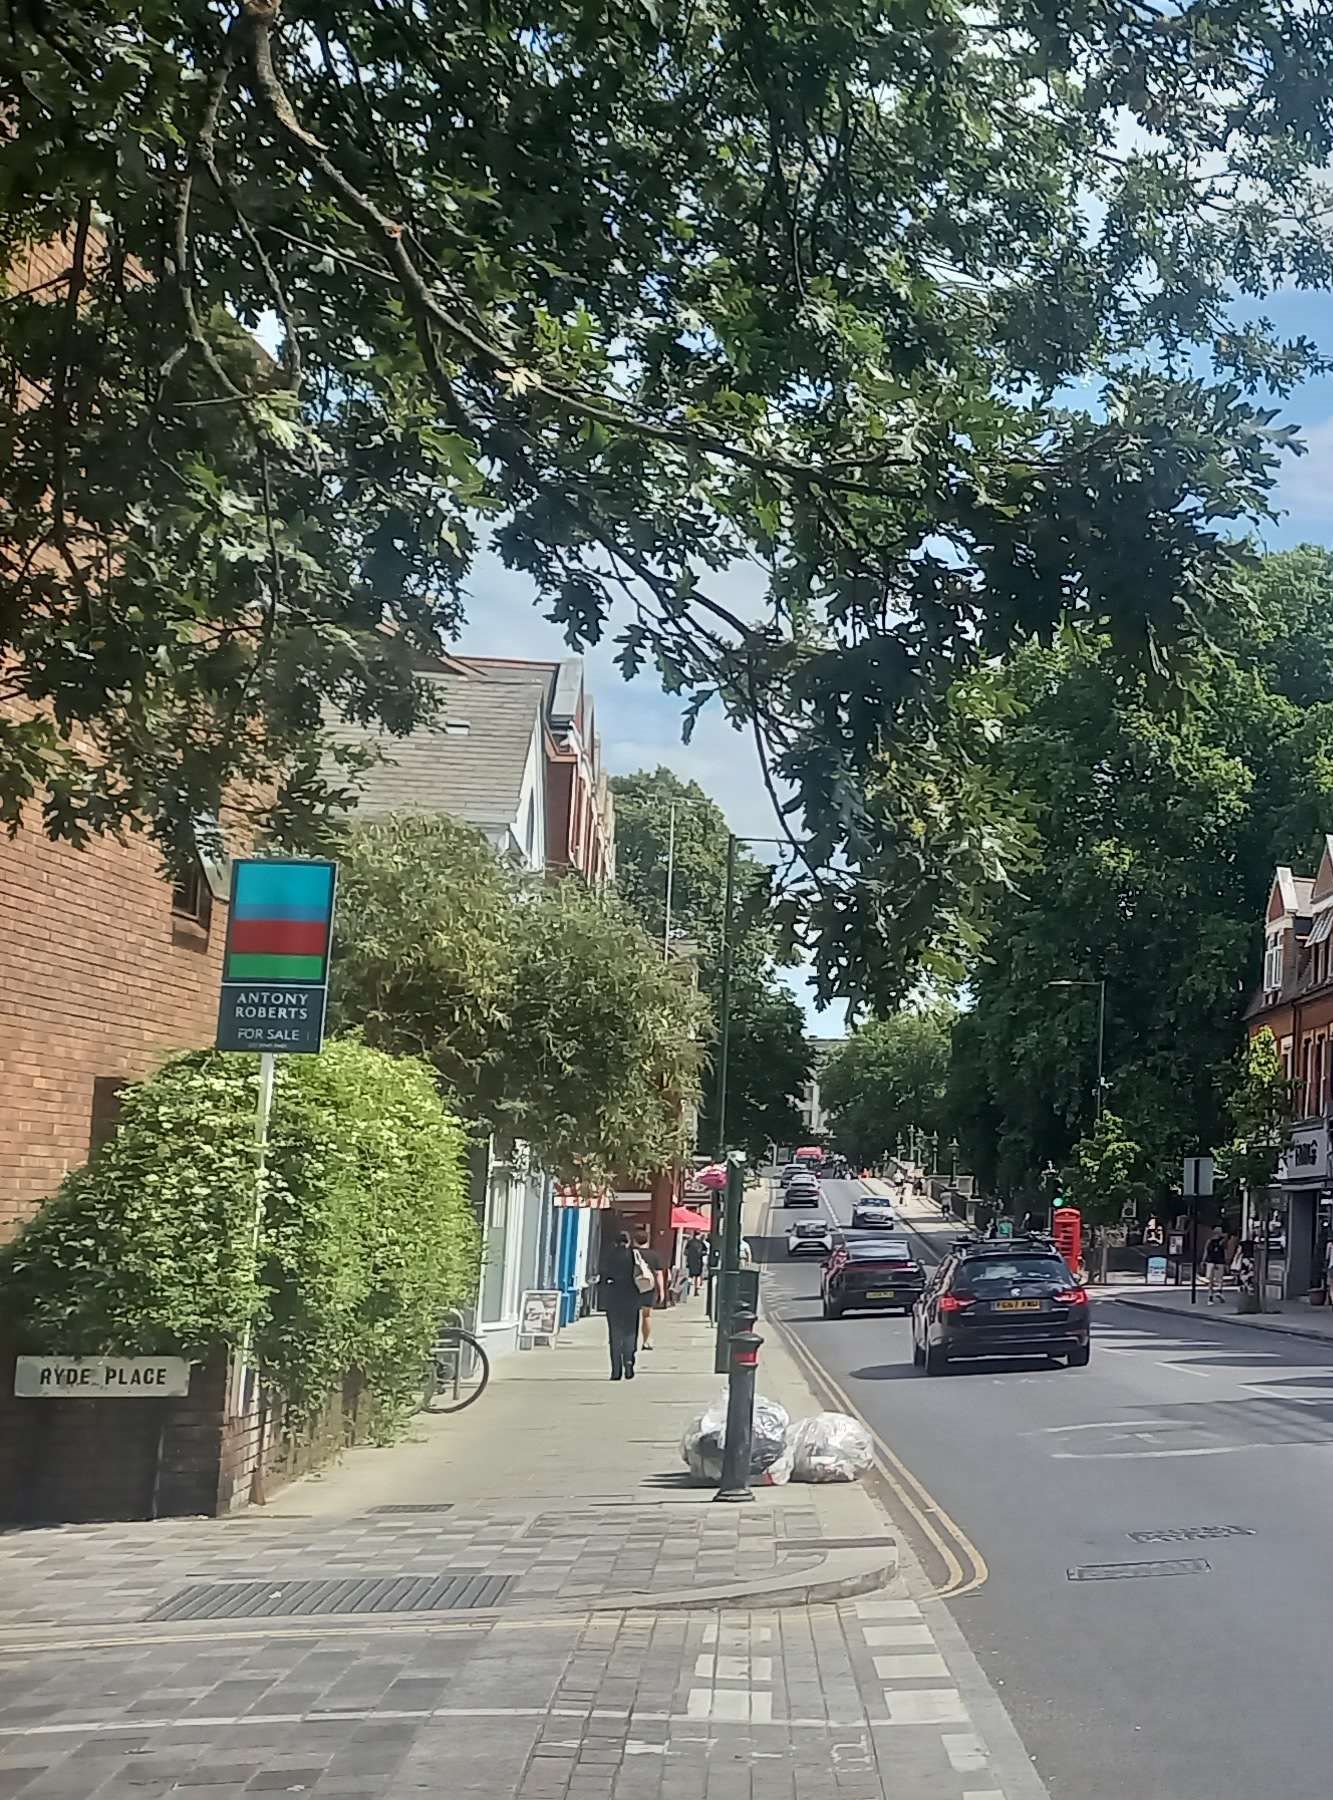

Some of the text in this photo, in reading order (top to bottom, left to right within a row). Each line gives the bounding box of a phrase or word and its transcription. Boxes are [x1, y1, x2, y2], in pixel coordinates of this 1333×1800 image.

[236, 992, 308, 1005] ANTONY
[235, 1006, 308, 1019] ROBERTS
[238, 1028, 300, 1041] FOR SALE
[40, 1367, 167, 1385] RYDE PLACE
